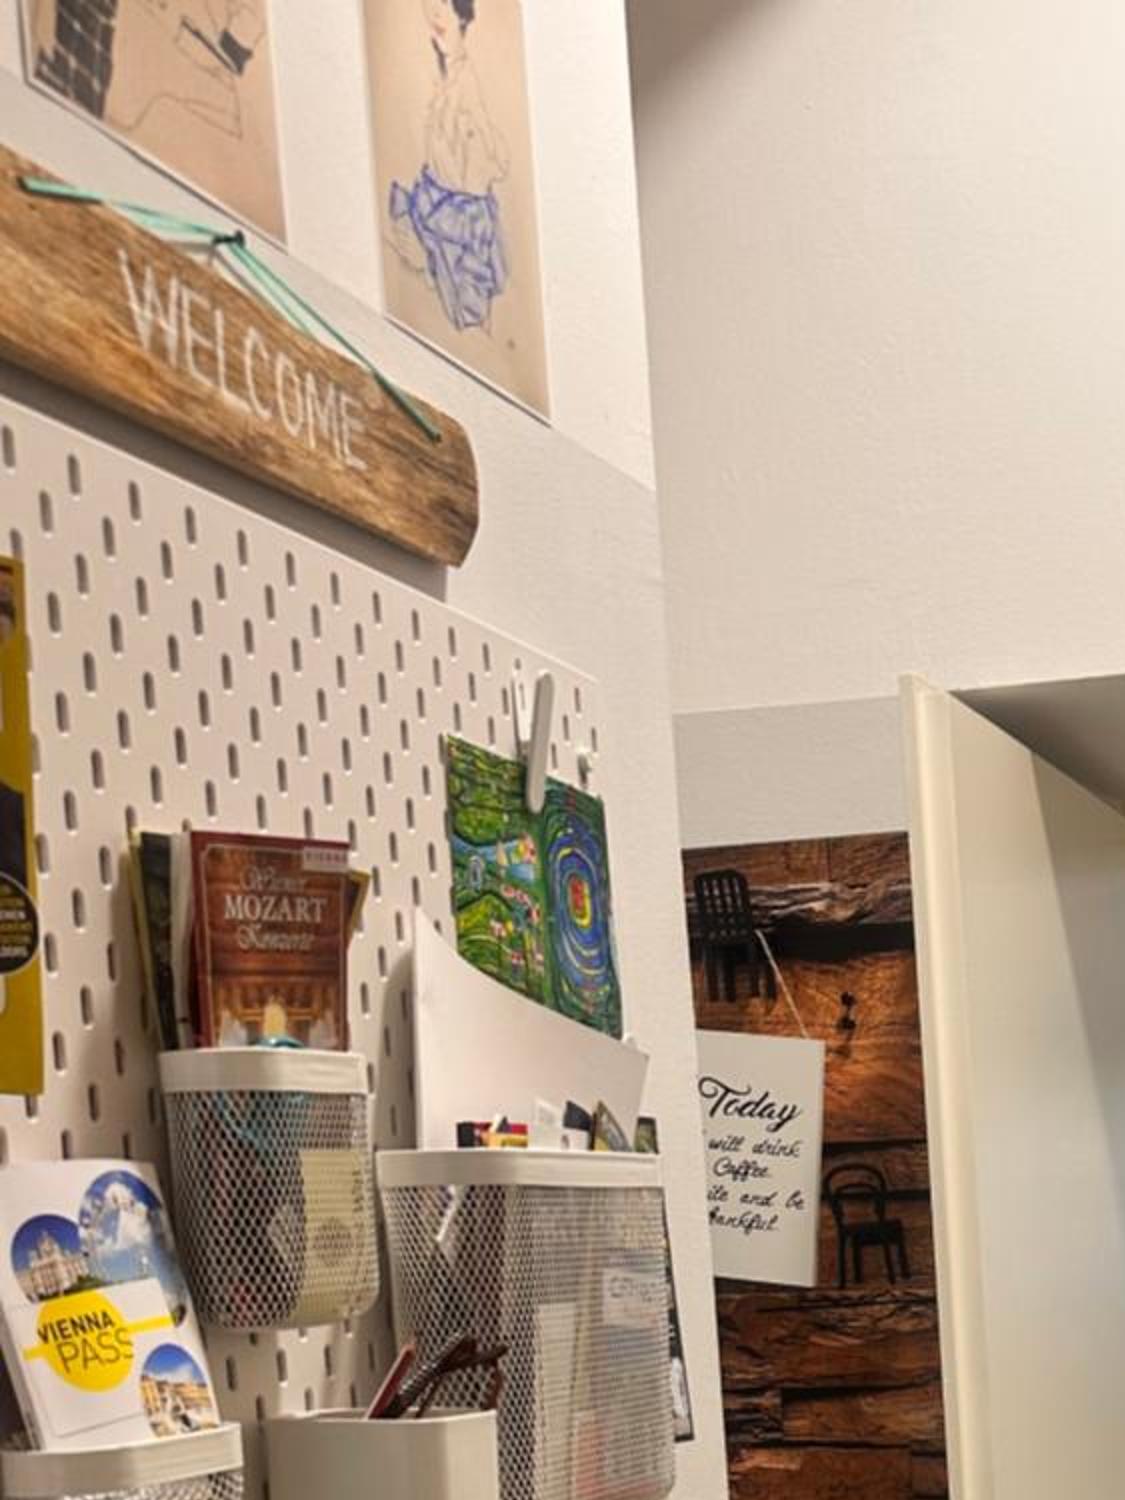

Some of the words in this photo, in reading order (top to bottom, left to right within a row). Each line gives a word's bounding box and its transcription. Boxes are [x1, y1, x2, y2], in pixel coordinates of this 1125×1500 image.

[117, 247, 369, 472] WELCOME
[224, 894, 329, 923] MOZART
[698, 1076, 802, 1133] Today
[708, 1135, 746, 1152] will
[752, 1139, 803, 1158] drink
[712, 1156, 772, 1182] Coffee
[740, 1191, 779, 1207] and
[785, 1190, 805, 1210] be
[37, 1309, 116, 1345] VIENNA
[56, 1327, 134, 1374] PASS
